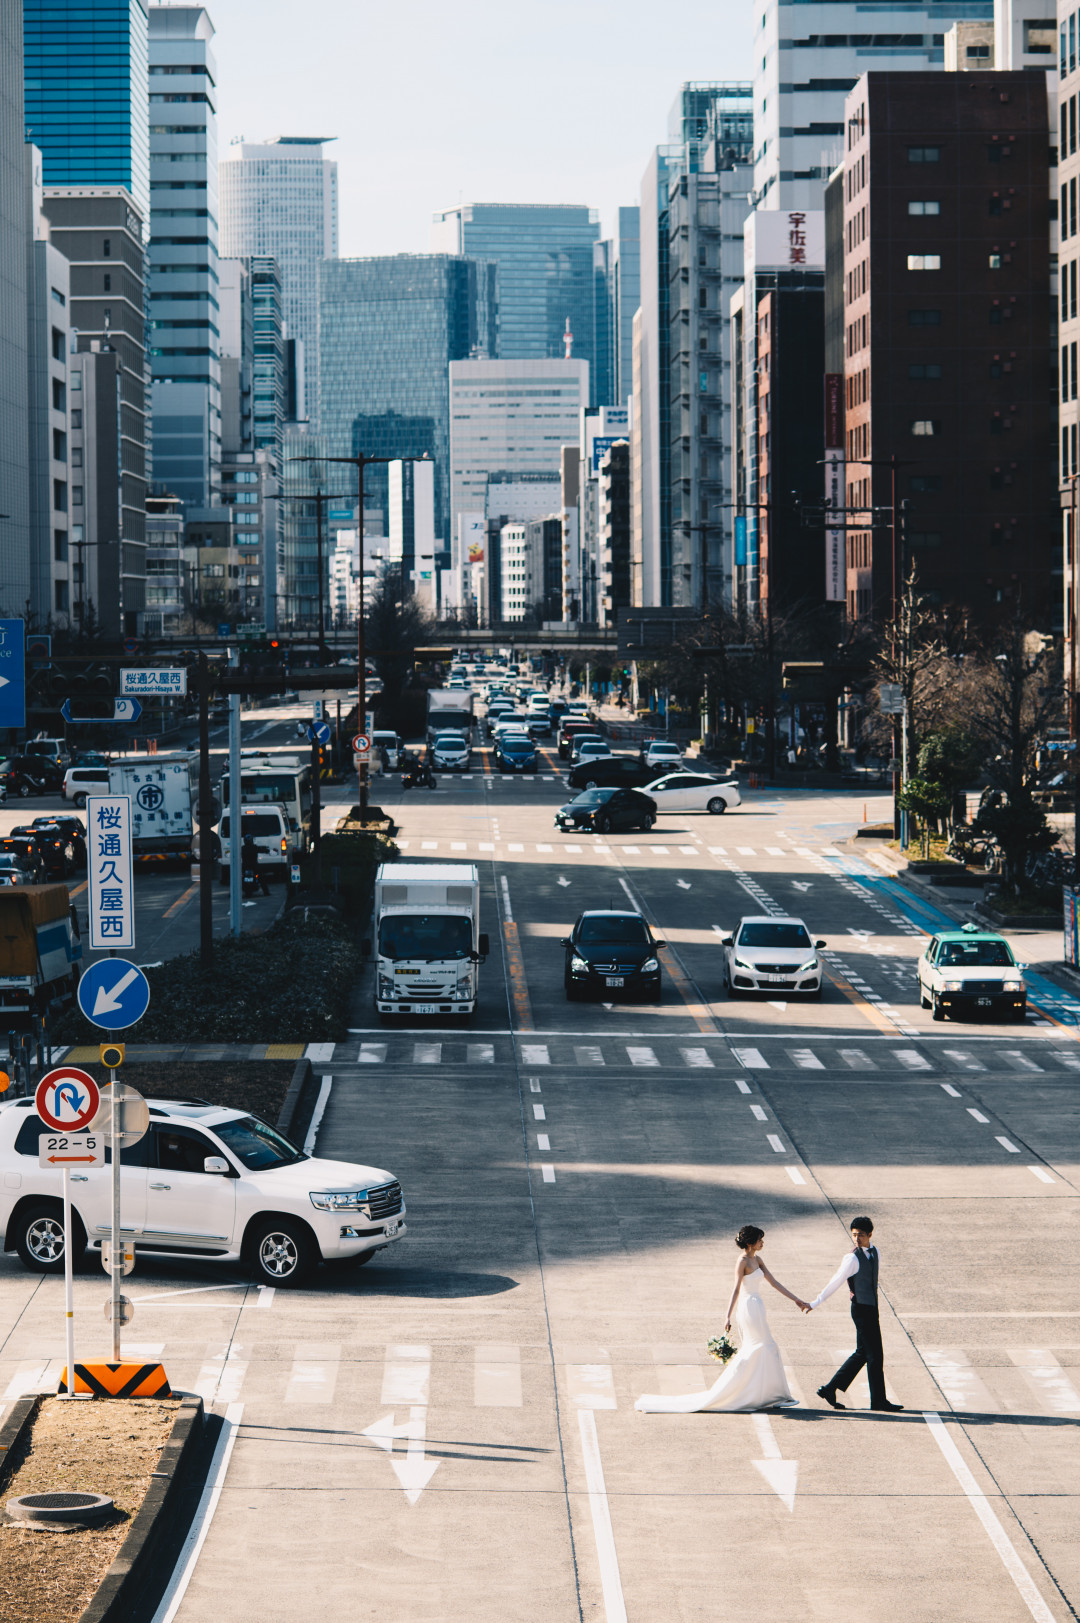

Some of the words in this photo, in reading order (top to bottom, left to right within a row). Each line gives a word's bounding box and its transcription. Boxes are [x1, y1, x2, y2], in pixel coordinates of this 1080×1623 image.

[788, 212, 806, 264] 宇佐美
[124, 685, 173, 693] Sakuradori-Hisaya
[125, 672, 181, 685] 桜通久屋西
[96, 805, 123, 938] 桜通久屋西
